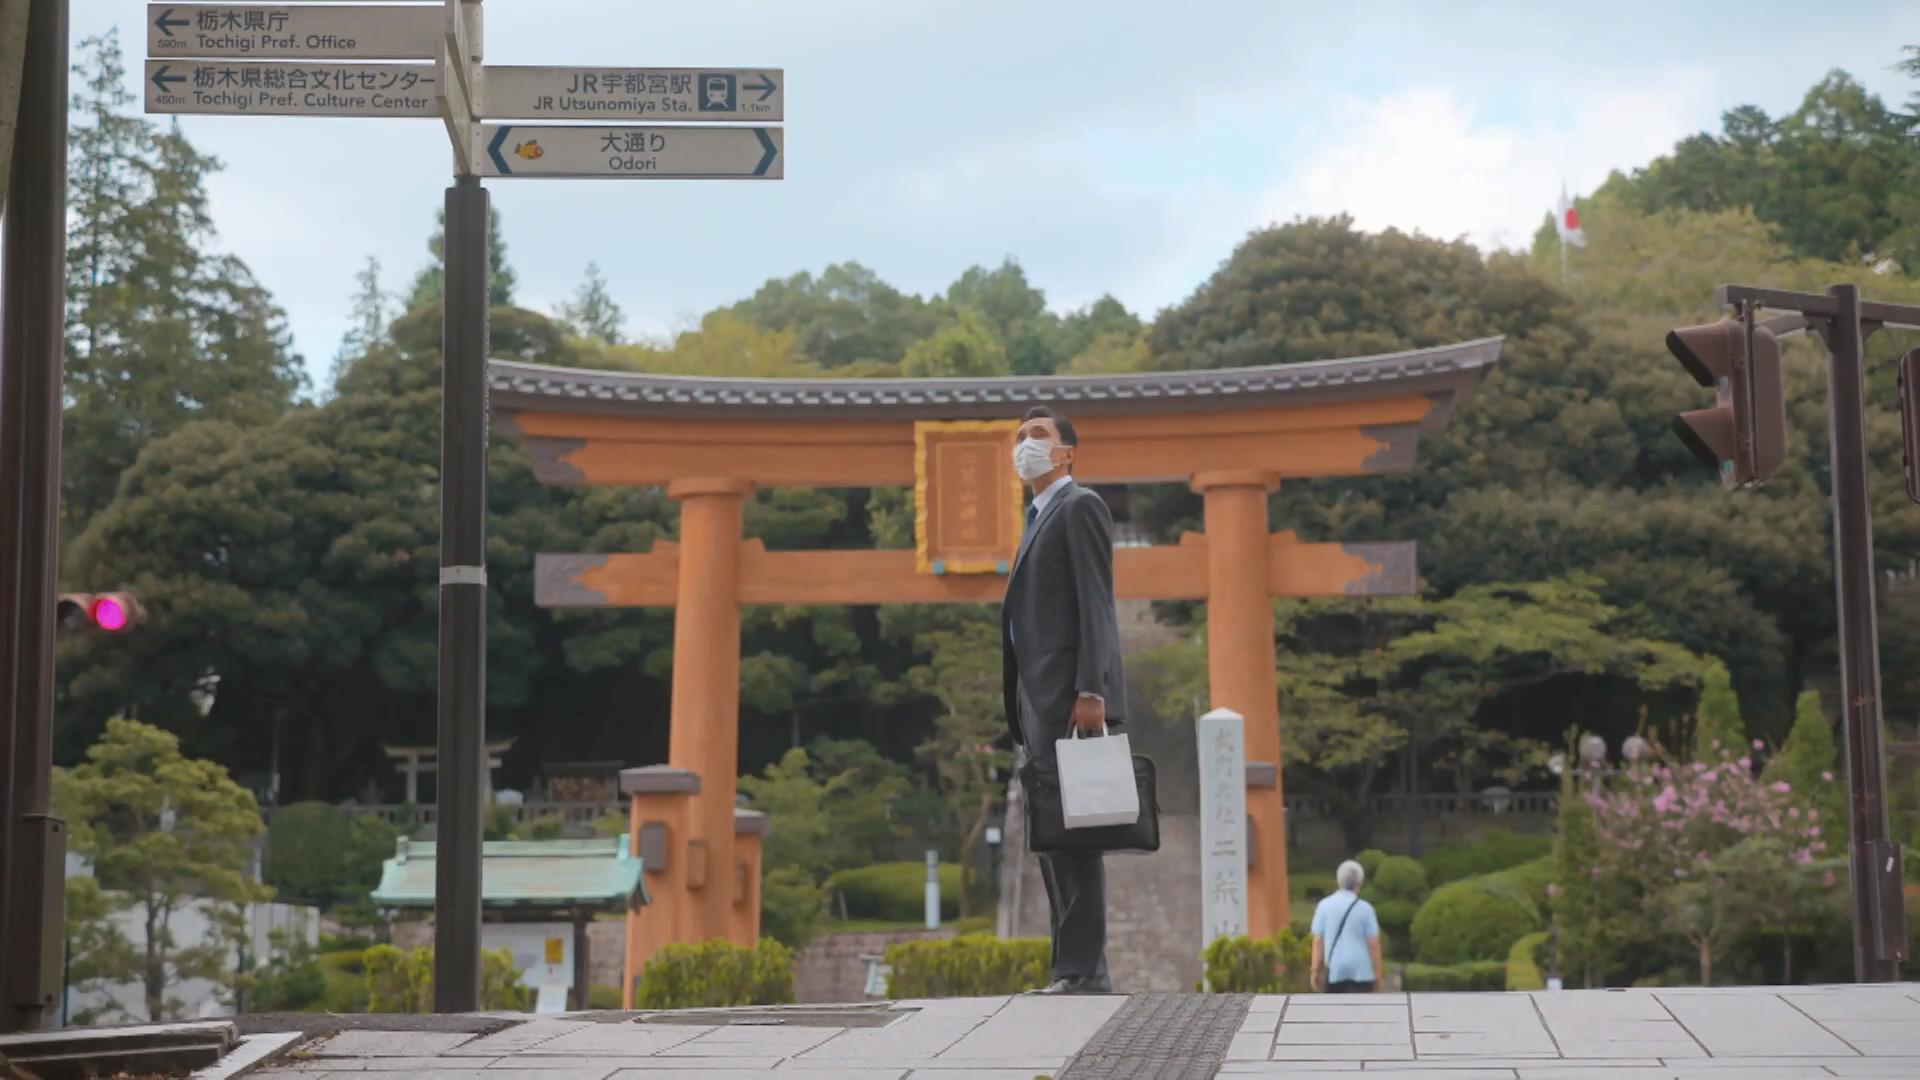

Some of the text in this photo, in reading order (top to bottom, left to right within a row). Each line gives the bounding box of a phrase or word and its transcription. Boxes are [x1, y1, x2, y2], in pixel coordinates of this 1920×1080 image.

[196, 10, 289, 32] 栃木県庁
[196, 34, 356, 52] Tochigi Pref. Office
[193, 66, 435, 90] 栃木県総合文化センター
[567, 73, 692, 94] JR宇都宮駅
[193, 91, 428, 109] Tochigi Pref. Culture Center
[533, 96, 693, 114] JR Utsunomiya Sta.
[600, 131, 665, 152] 大通り
[608, 155, 657, 170] Odori
